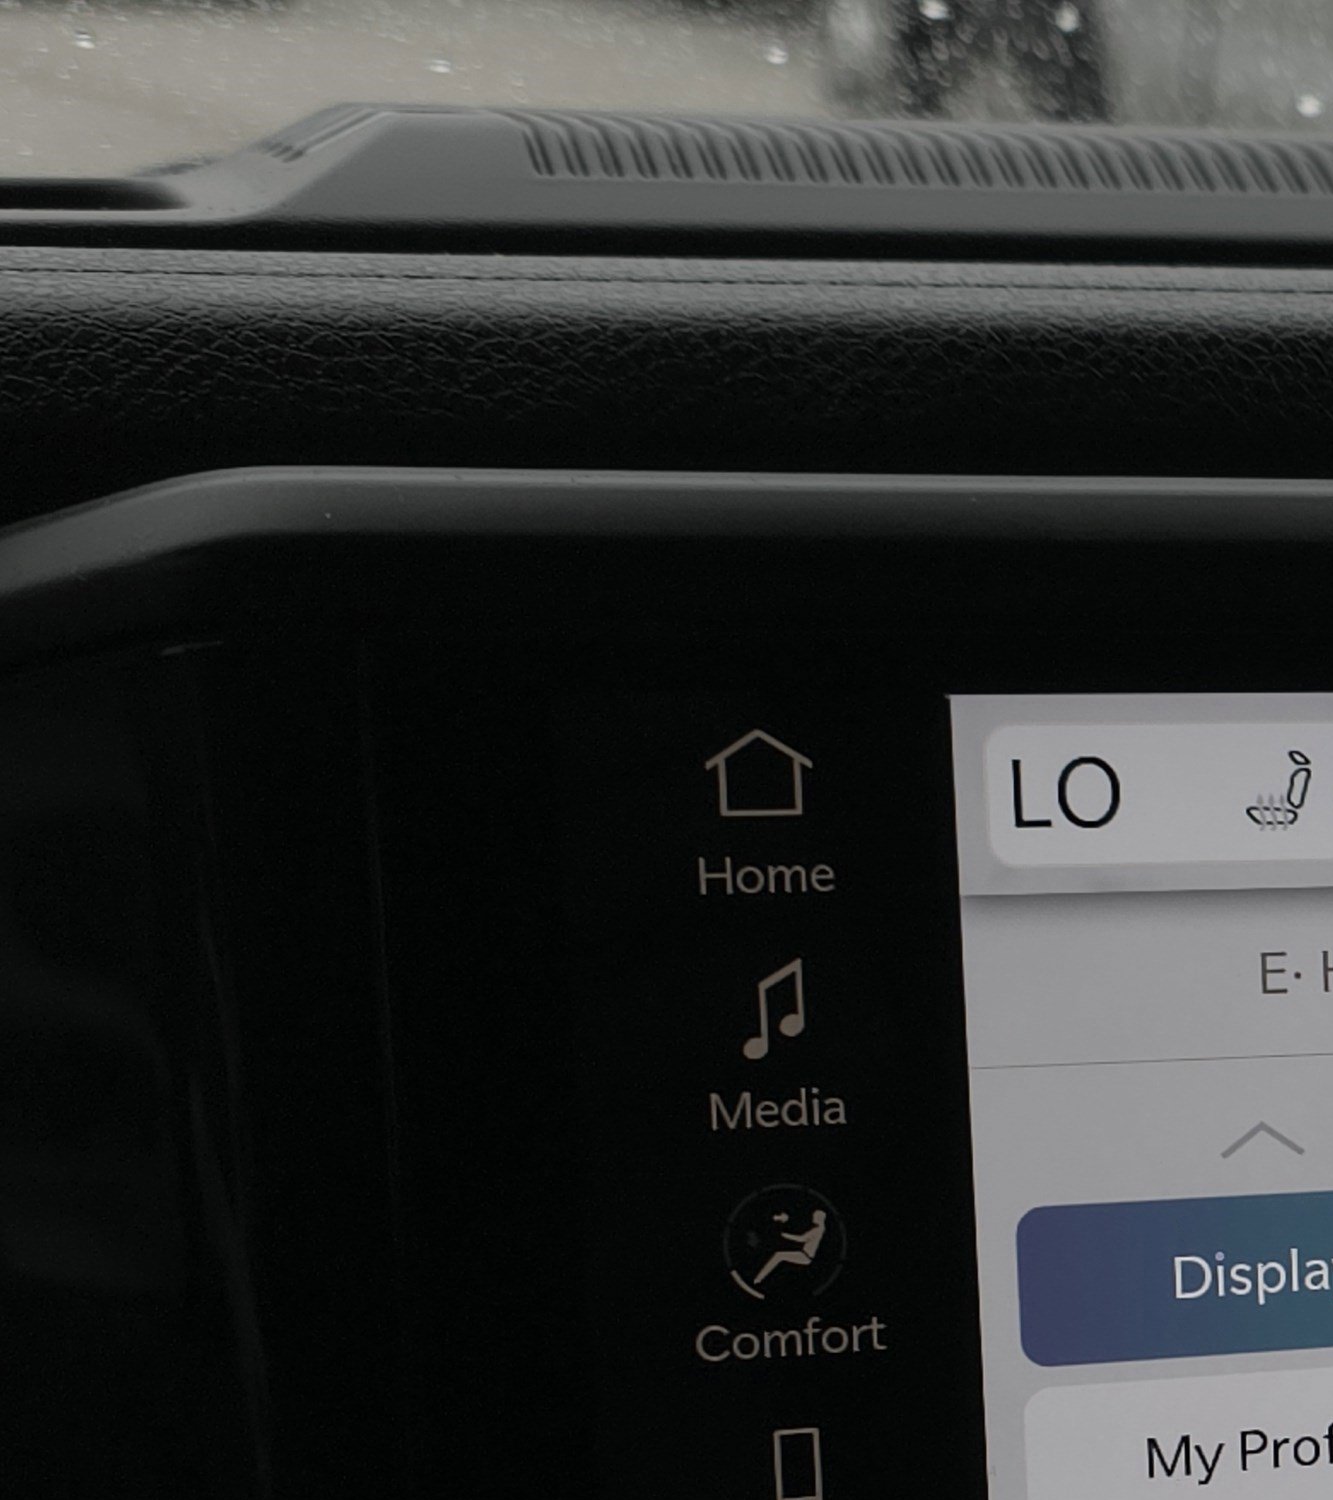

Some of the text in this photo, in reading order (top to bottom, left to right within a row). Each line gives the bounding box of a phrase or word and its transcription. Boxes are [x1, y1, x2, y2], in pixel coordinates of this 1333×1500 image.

[1011, 756, 1121, 829] LO
[698, 856, 835, 895] Home
[709, 1087, 847, 1131] Media
[695, 1316, 887, 1362] Comfort
[1146, 1434, 1225, 1486] My
